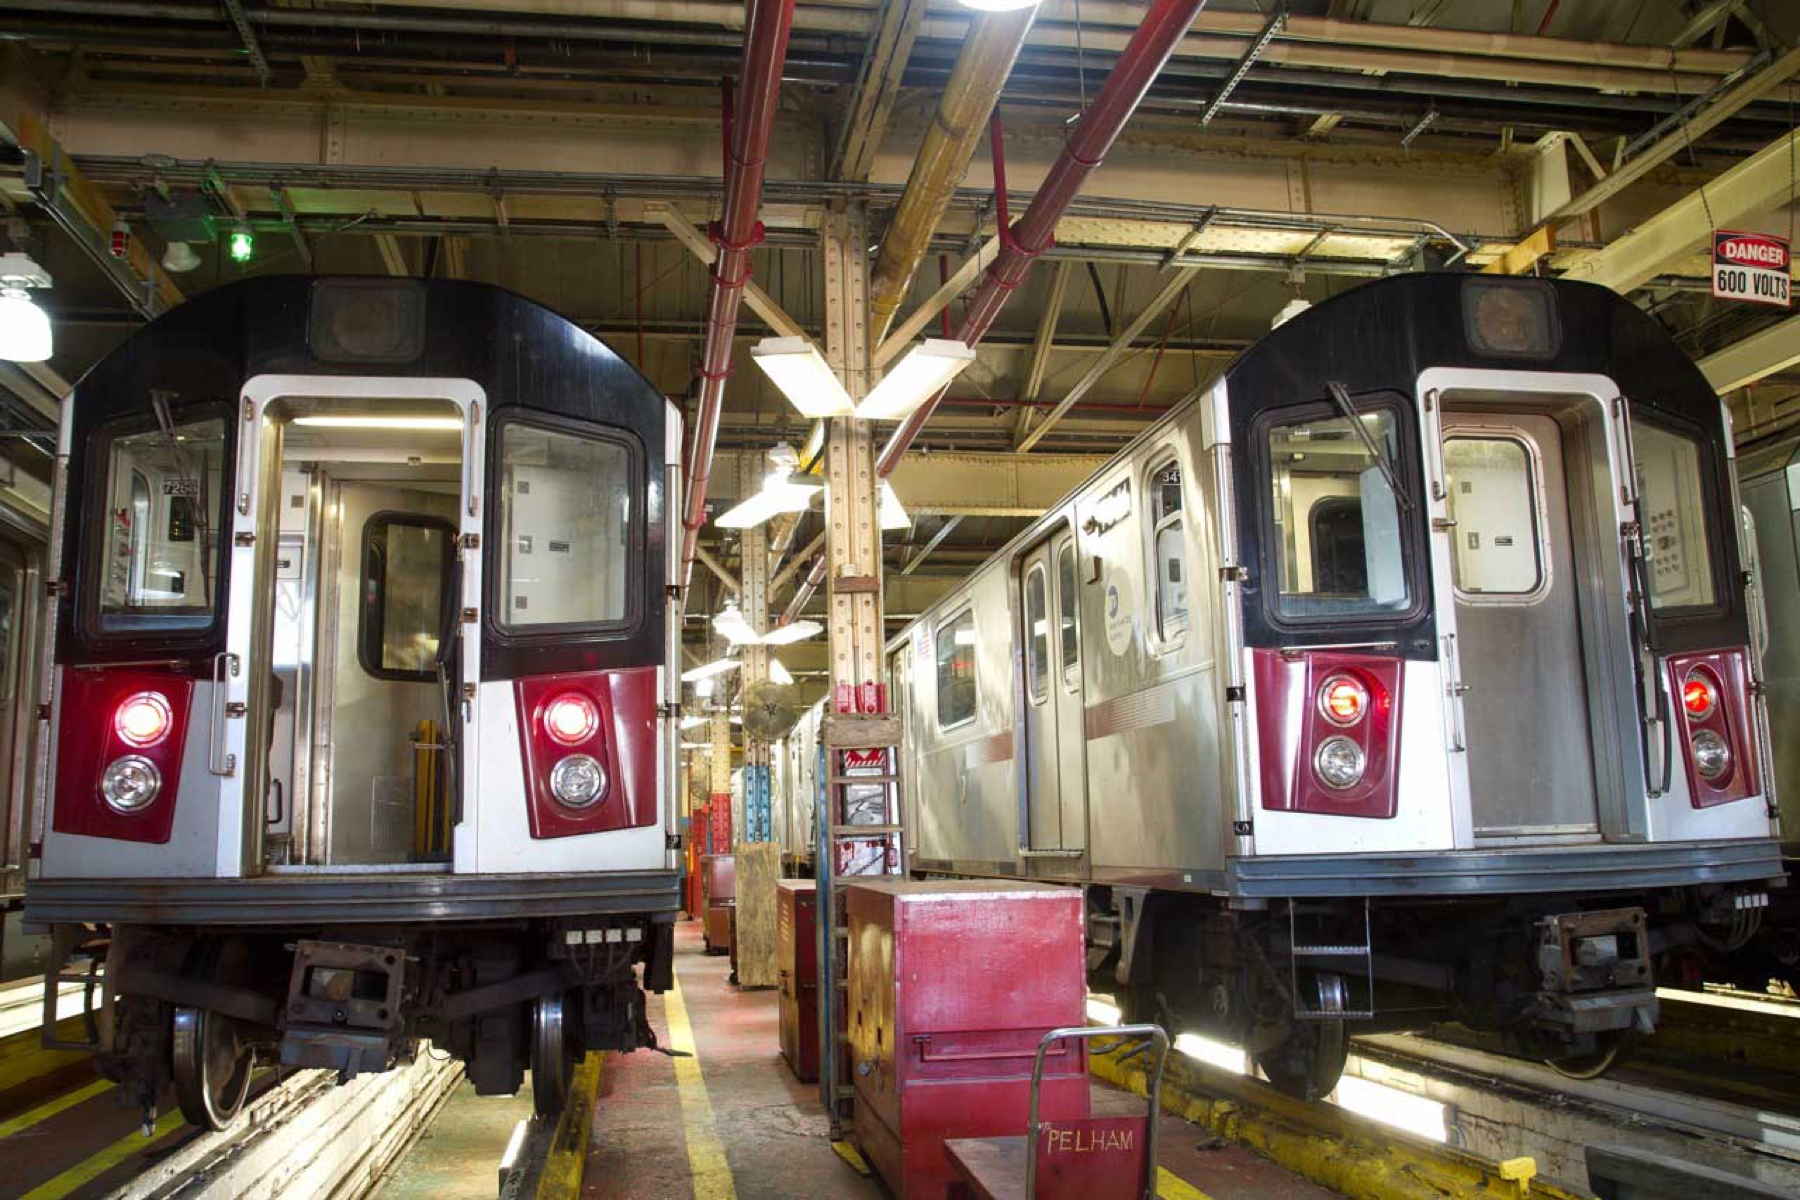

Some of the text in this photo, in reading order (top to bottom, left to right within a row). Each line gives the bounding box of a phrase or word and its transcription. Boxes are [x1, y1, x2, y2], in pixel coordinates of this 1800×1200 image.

[1726, 241, 1784, 266] DANGER
[1718, 269, 1788, 300] 600 VOLTS
[1047, 1129, 1133, 1155] PELHAM
